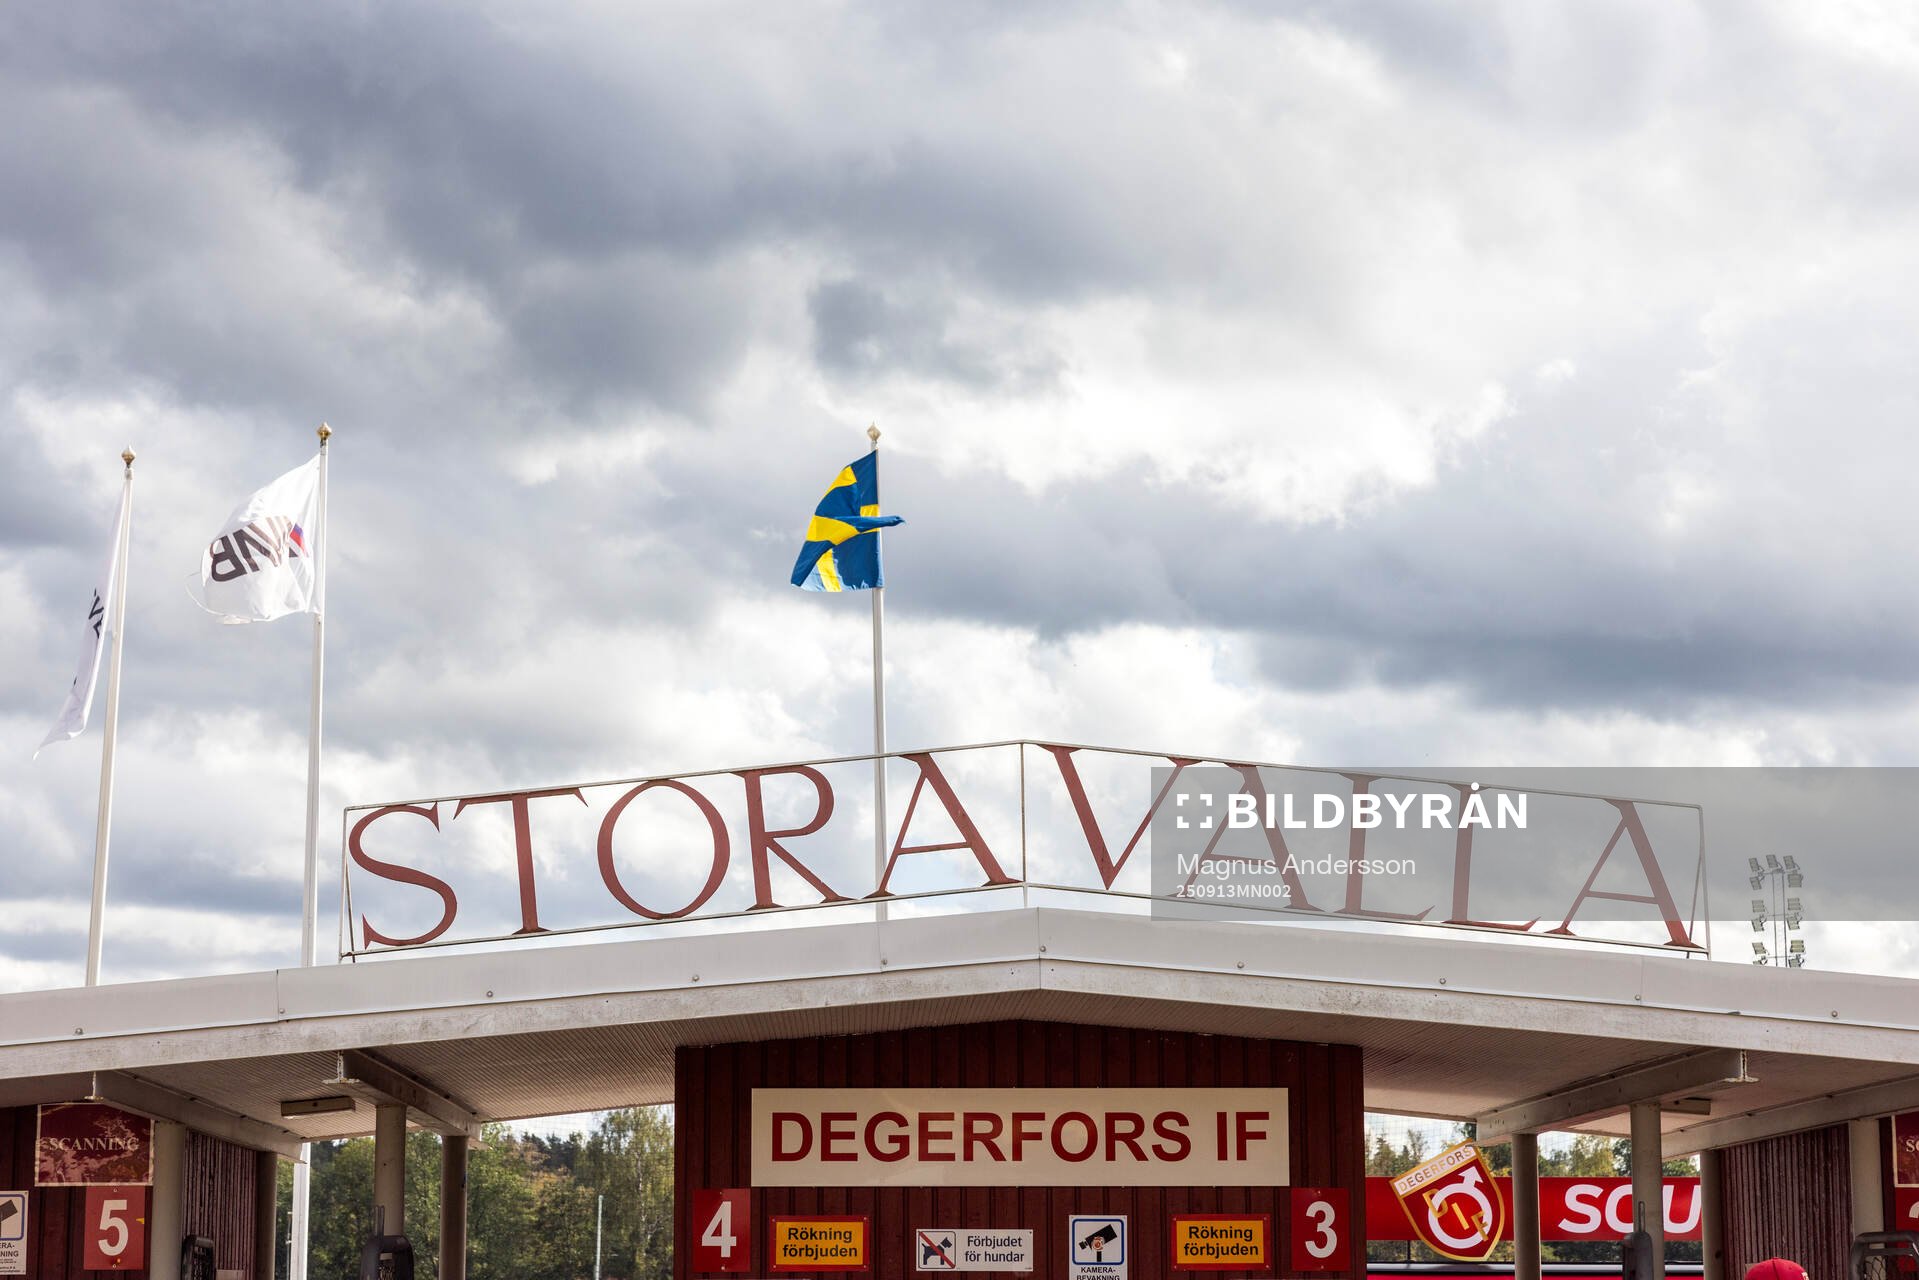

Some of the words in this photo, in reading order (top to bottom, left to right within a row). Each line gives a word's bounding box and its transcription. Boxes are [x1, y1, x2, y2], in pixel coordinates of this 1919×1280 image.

[349, 752, 1024, 950] STORA
[1036, 744, 1704, 950] VALLA
[50, 1137, 140, 1151] SCANNING
[771, 1110, 1192, 1162] DEGERFORS
[1217, 1111, 1270, 1161] IF
[1397, 1147, 1473, 1192] DEGERFORS
[98, 1199, 129, 1256] 5
[702, 1201, 737, 1257] 4
[788, 1227, 852, 1243] Rökning
[1188, 1226, 1253, 1241] Rökning
[1305, 1201, 1338, 1258] 3
[967, 1235, 1022, 1249] Förbjudet
[783, 1244, 857, 1260] förbjuden
[965, 1251, 981, 1262] för
[984, 1251, 1024, 1262] hundar
[1184, 1243, 1258, 1259] förbjuden
